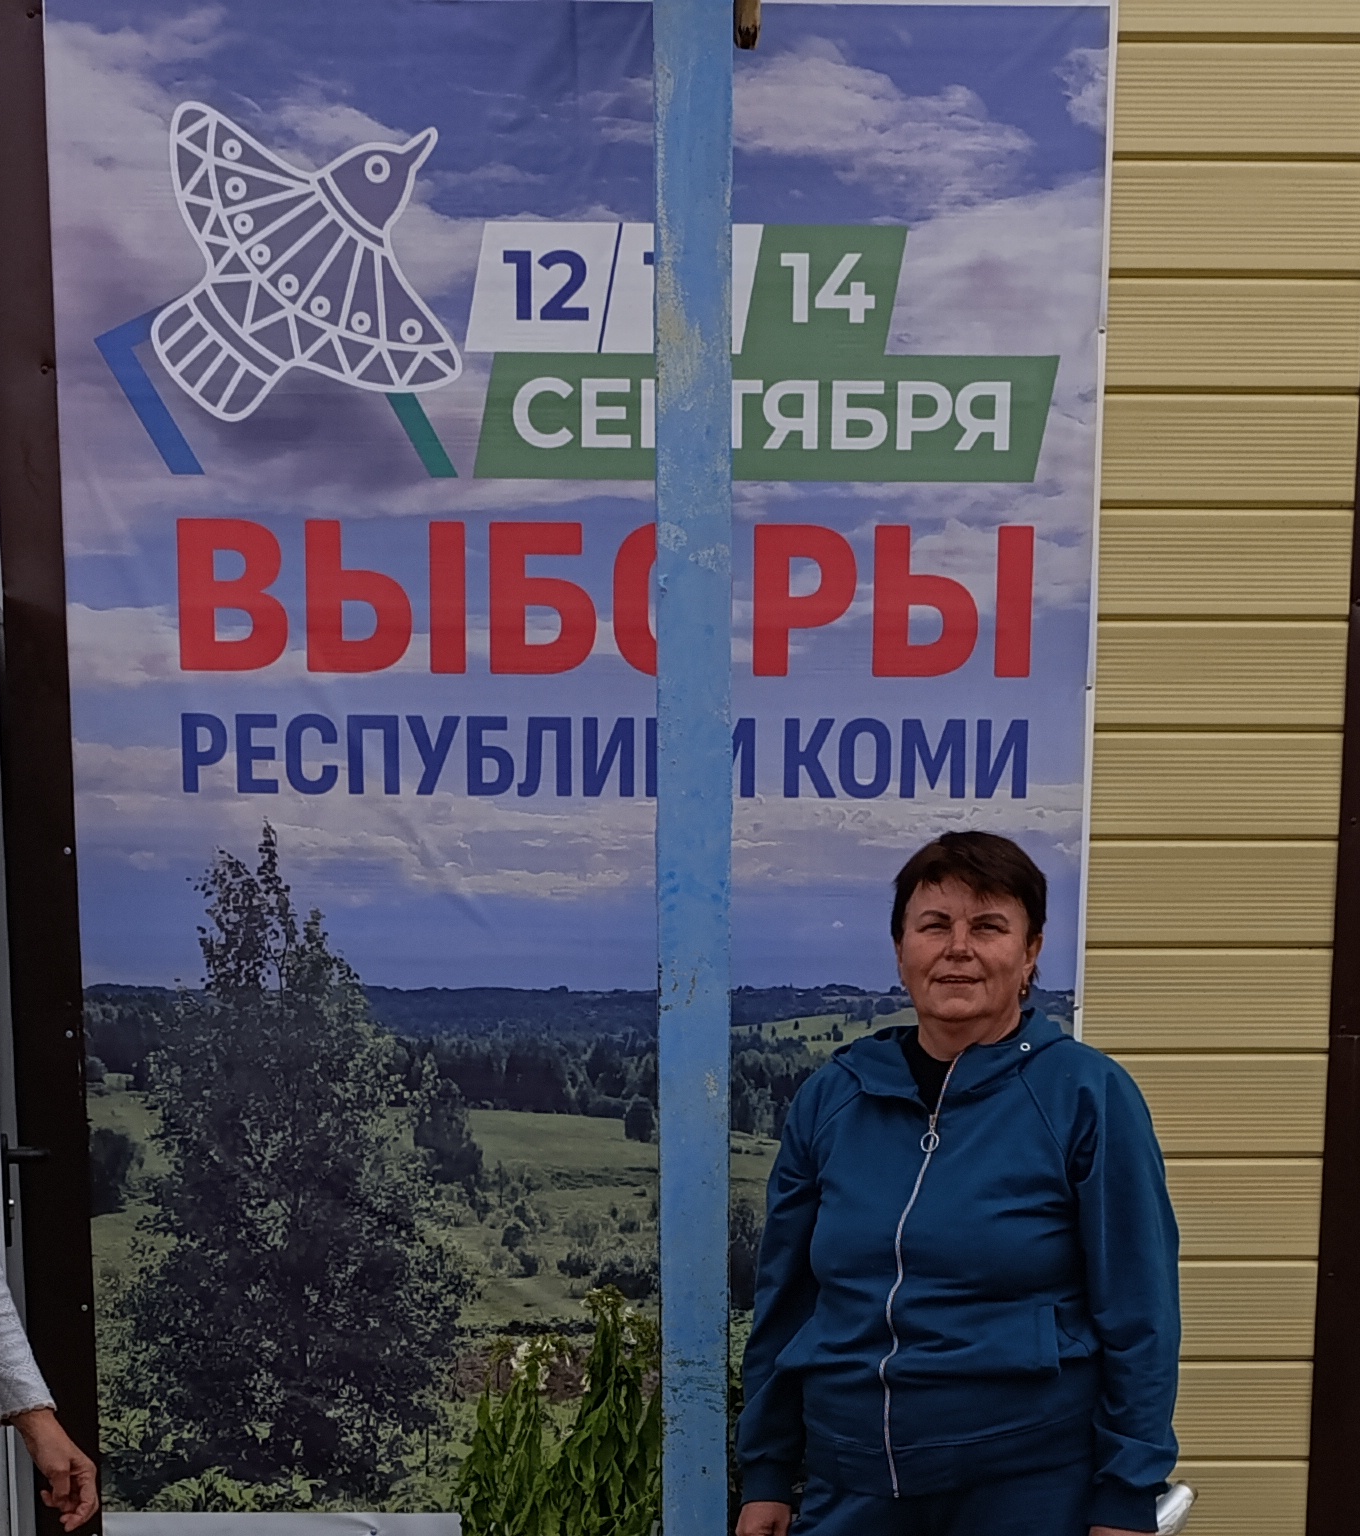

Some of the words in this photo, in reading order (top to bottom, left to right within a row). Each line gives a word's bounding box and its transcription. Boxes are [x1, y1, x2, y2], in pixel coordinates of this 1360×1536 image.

[503, 250, 590, 321] 12
[780, 252, 876, 324] 14
[513, 377, 1012, 452] СЕТЯБРЯ
[783, 717, 1029, 799] КОМИ
